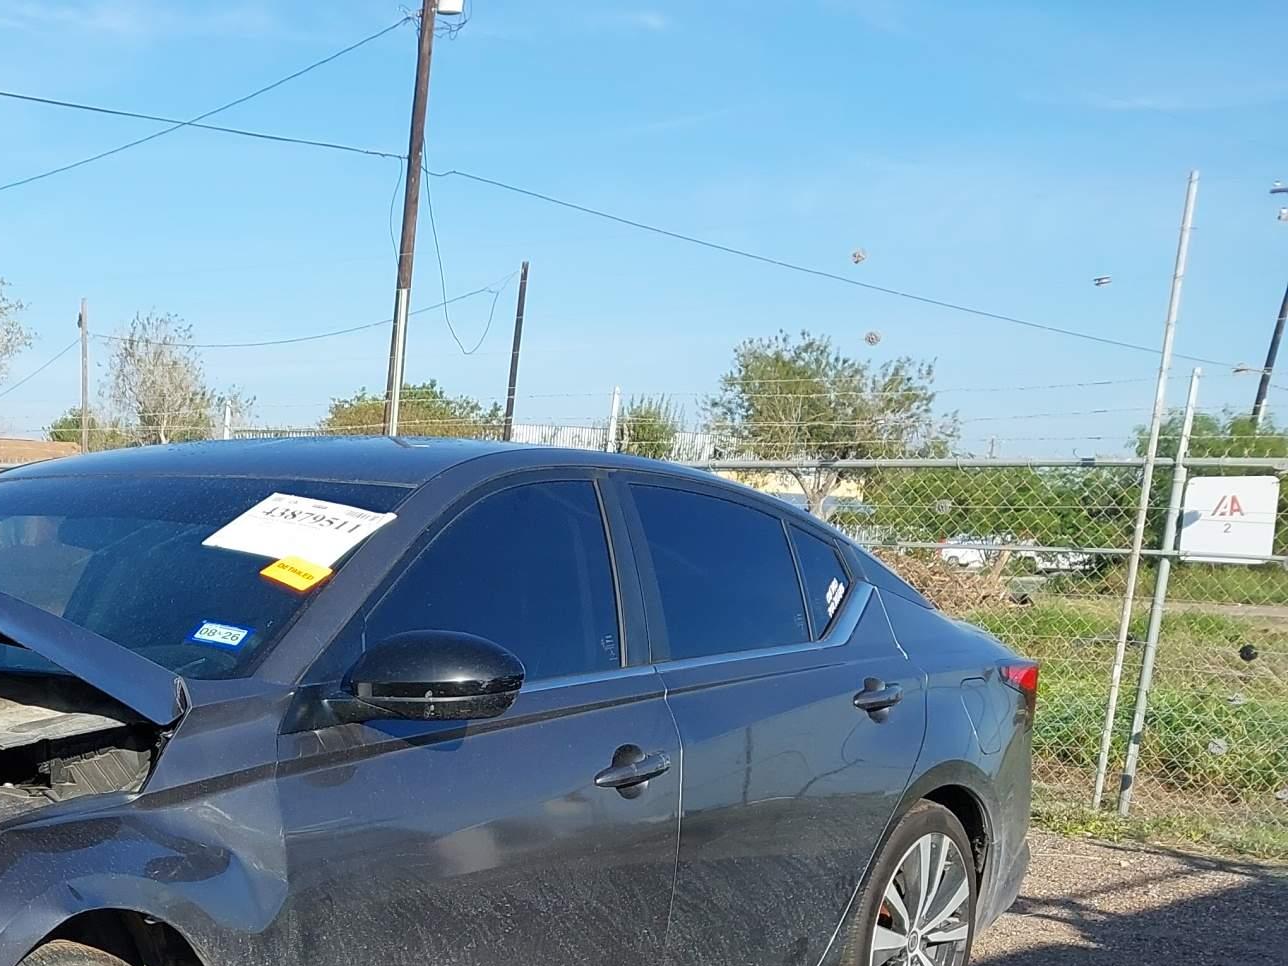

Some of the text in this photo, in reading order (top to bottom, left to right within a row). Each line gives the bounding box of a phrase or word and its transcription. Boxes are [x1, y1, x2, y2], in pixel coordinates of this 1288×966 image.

[262, 506, 361, 534] 43879511
[1223, 523, 1232, 534] 2
[199, 627, 241, 642] 08 26
